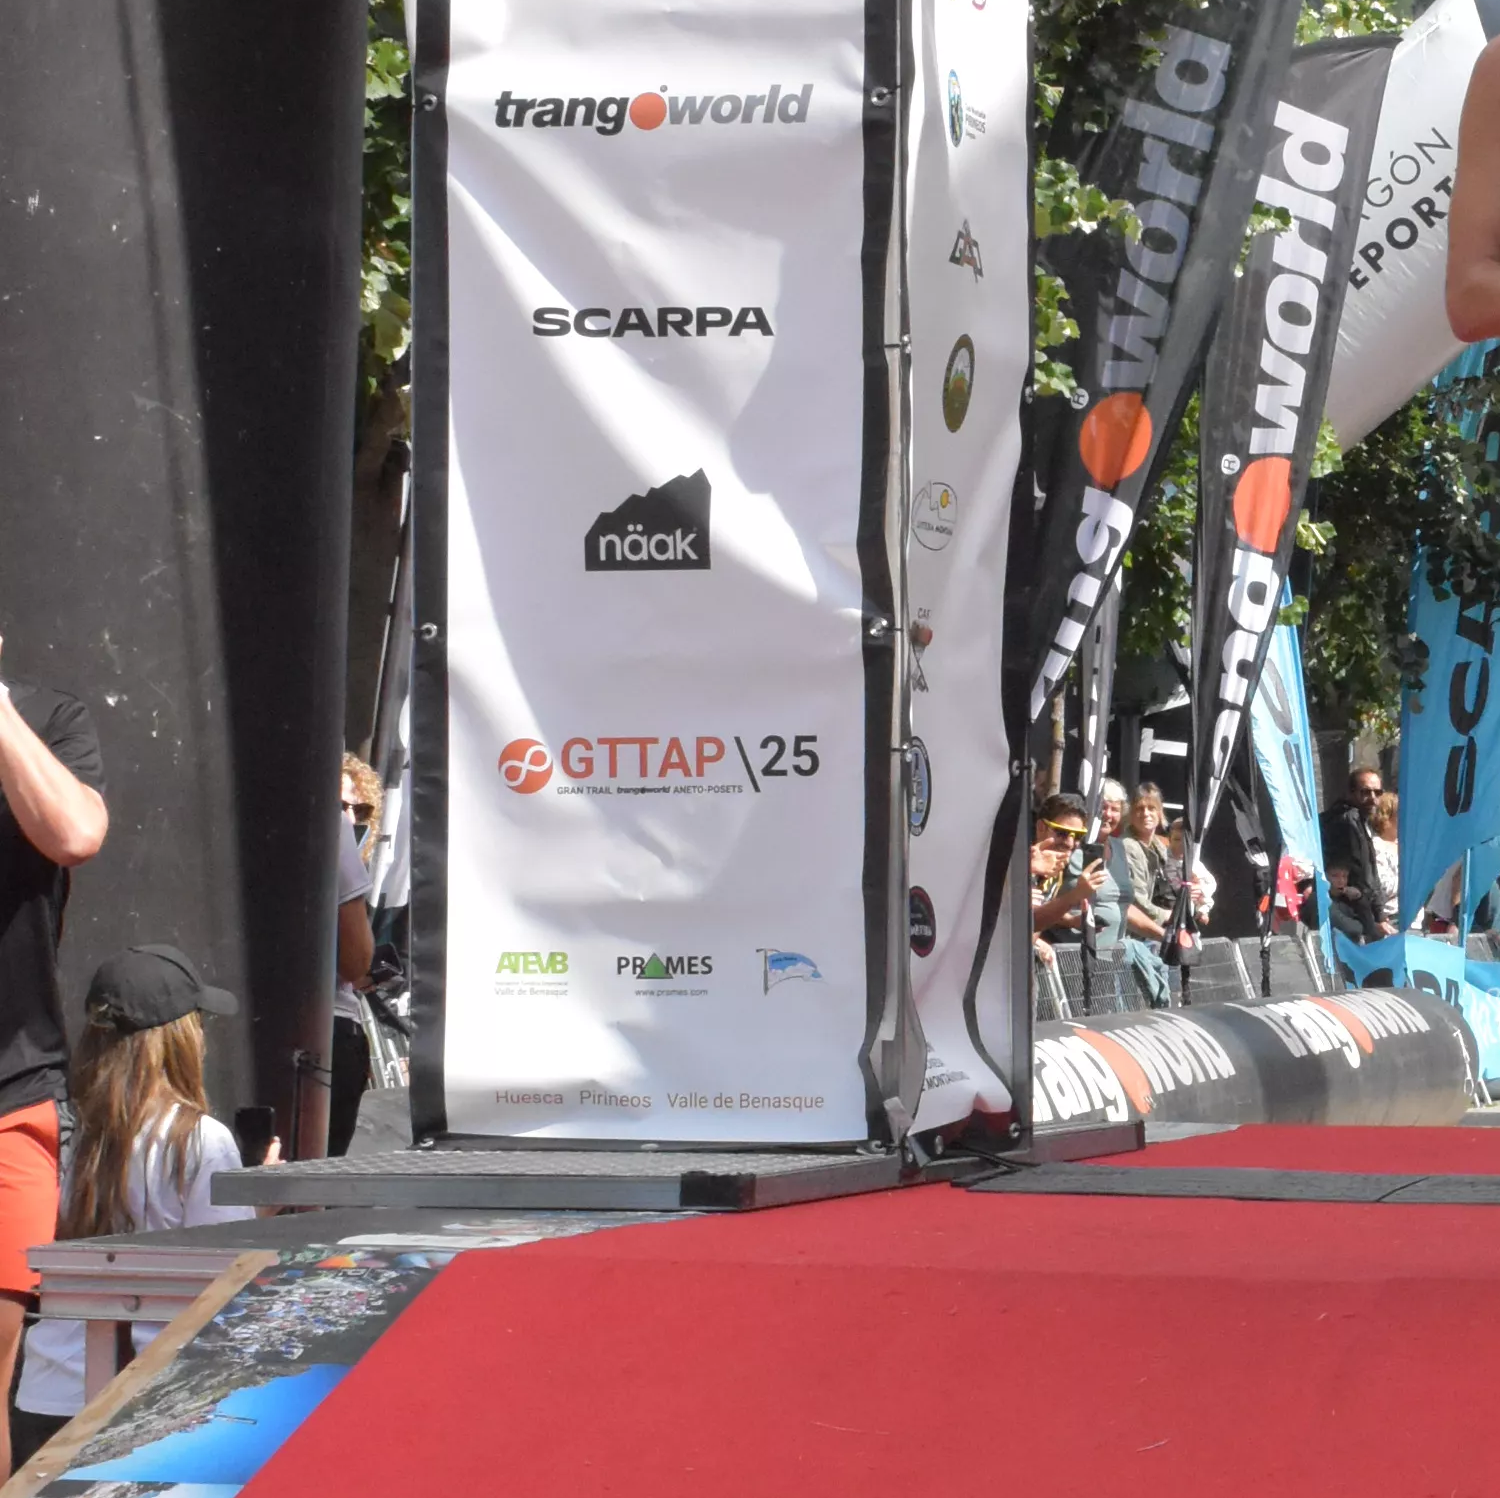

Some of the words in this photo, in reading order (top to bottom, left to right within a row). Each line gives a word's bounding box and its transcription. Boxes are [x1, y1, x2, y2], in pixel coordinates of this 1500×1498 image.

[532, 306, 775, 338] SCARPA
[599, 523, 699, 561] näak
[557, 786, 584, 795] GRAN
[586, 786, 612, 794] TRAIL
[673, 784, 744, 794] ANETO-POSETS
[495, 951, 569, 975] ATEVB
[616, 953, 713, 979] PRAMES
[635, 989, 708, 997] www.prames.com
[495, 1090, 564, 1106] Huesca
[579, 1089, 652, 1109] Pirineos
[667, 1093, 711, 1109] Valle
[713, 1093, 735, 1109] de
[739, 1093, 825, 1113] Benasque
